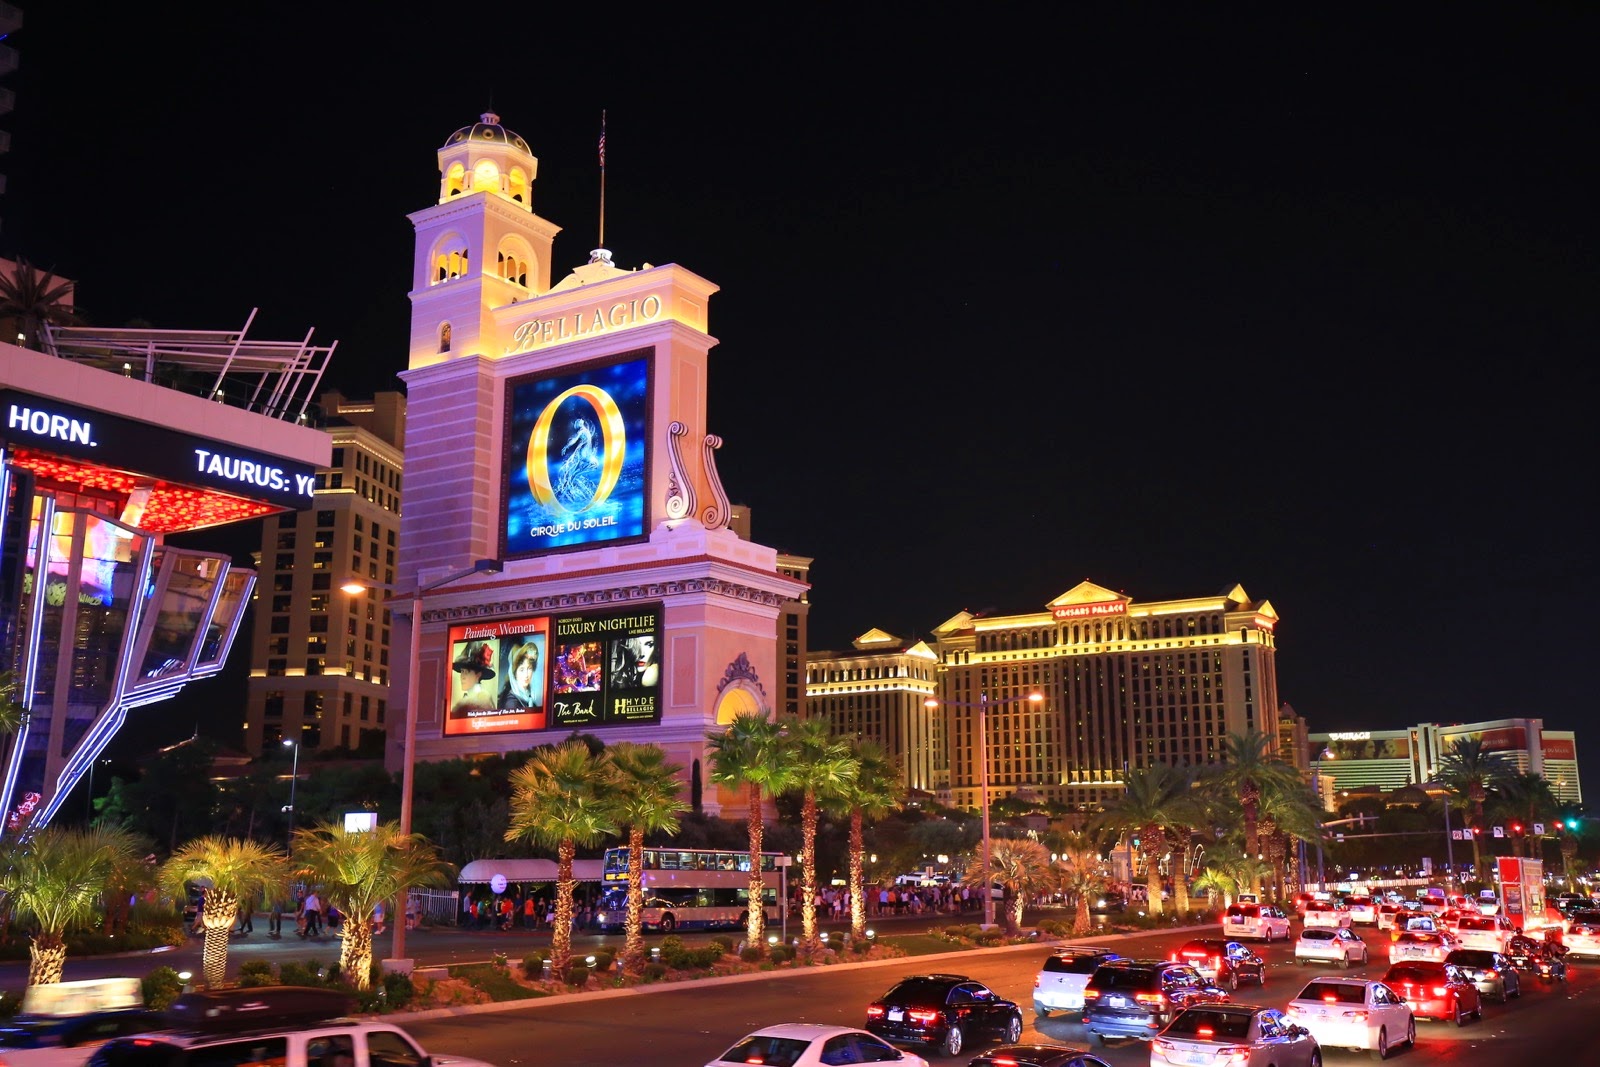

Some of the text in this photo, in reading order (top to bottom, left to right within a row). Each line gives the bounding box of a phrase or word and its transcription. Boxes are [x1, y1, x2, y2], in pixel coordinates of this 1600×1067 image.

[505, 295, 662, 354] BELLAGIO
[9, 405, 97, 447] HORN.
[195, 449, 290, 491] TAURUS:
[530, 515, 617, 537] CIRQUE DU SOLEIL
[1055, 604, 1123, 617] CAESARS PALACE
[464, 623, 535, 640] Painting Women
[558, 615, 655, 636] LUXURY NIGHTLIFE
[554, 699, 597, 717] The Bank
[627, 696, 655, 705] HYDE
